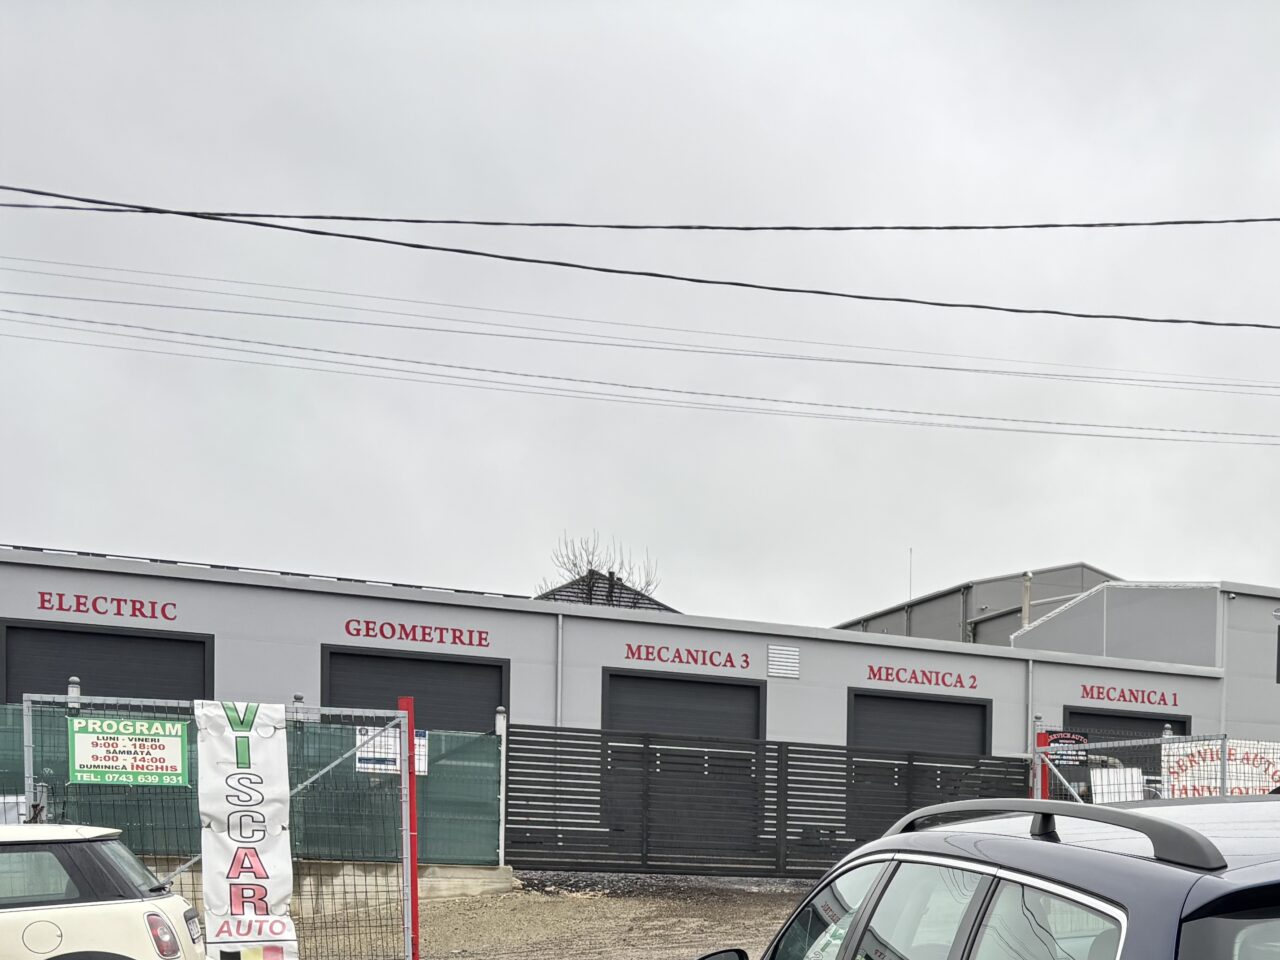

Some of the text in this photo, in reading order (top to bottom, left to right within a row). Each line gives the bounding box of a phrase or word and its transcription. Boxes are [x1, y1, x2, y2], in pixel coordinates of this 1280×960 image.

[38, 591, 177, 621] ELECTRIC
[345, 618, 490, 648] GEOMETRIE
[625, 643, 750, 669] MECANICA 3
[867, 665, 977, 689] MECANICA 2
[1081, 684, 1178, 706] MECANICA 1
[73, 718, 182, 735] PROGRAM
[91, 741, 118, 749] 9:00
[131, 743, 166, 751] 18:00
[91, 754, 118, 762] 9:00
[131, 756, 166, 764] 14:00
[75, 773, 183, 784] TEL: 0743 639 931
[215, 920, 286, 938] AUTO
